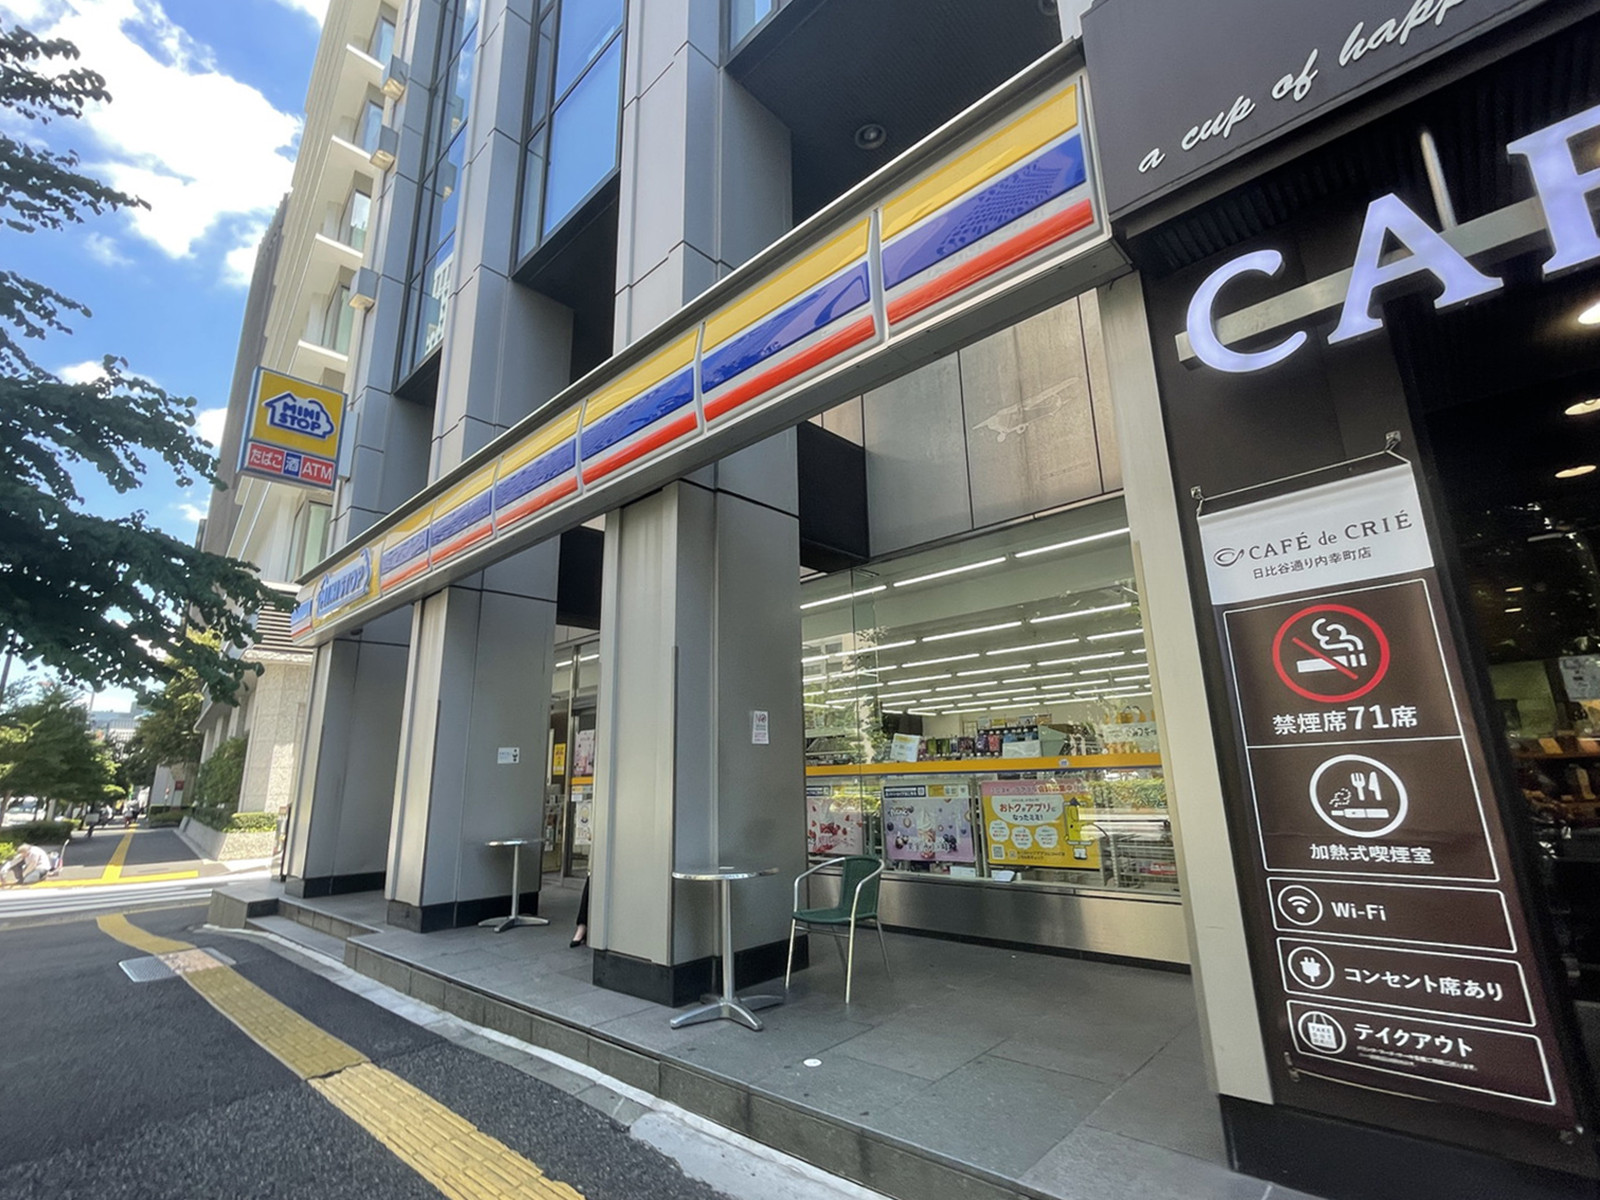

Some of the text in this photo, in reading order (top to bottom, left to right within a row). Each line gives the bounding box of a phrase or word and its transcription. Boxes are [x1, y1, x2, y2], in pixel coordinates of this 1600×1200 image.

[1138, 148, 1165, 173] a
[1181, 95, 1256, 151] cup
[1271, 48, 1318, 101] of
[278, 413, 322, 432] STOP
[282, 401, 320, 421] MINI
[250, 448, 333, 480] たばこ 酒 ATM
[1249, 510, 1412, 560] CAFÉ de CRIÉ
[1253, 546, 1372, 580] 日比谷通り内幸町店
[1272, 704, 1418, 735] 禁煙席71席
[1309, 843, 1434, 864] 加熱式喫煙室
[1331, 901, 1387, 921] Wi-Fi
[1344, 967, 1504, 1001] コンセント席あり
[1354, 1023, 1473, 1057] テイクアウト
